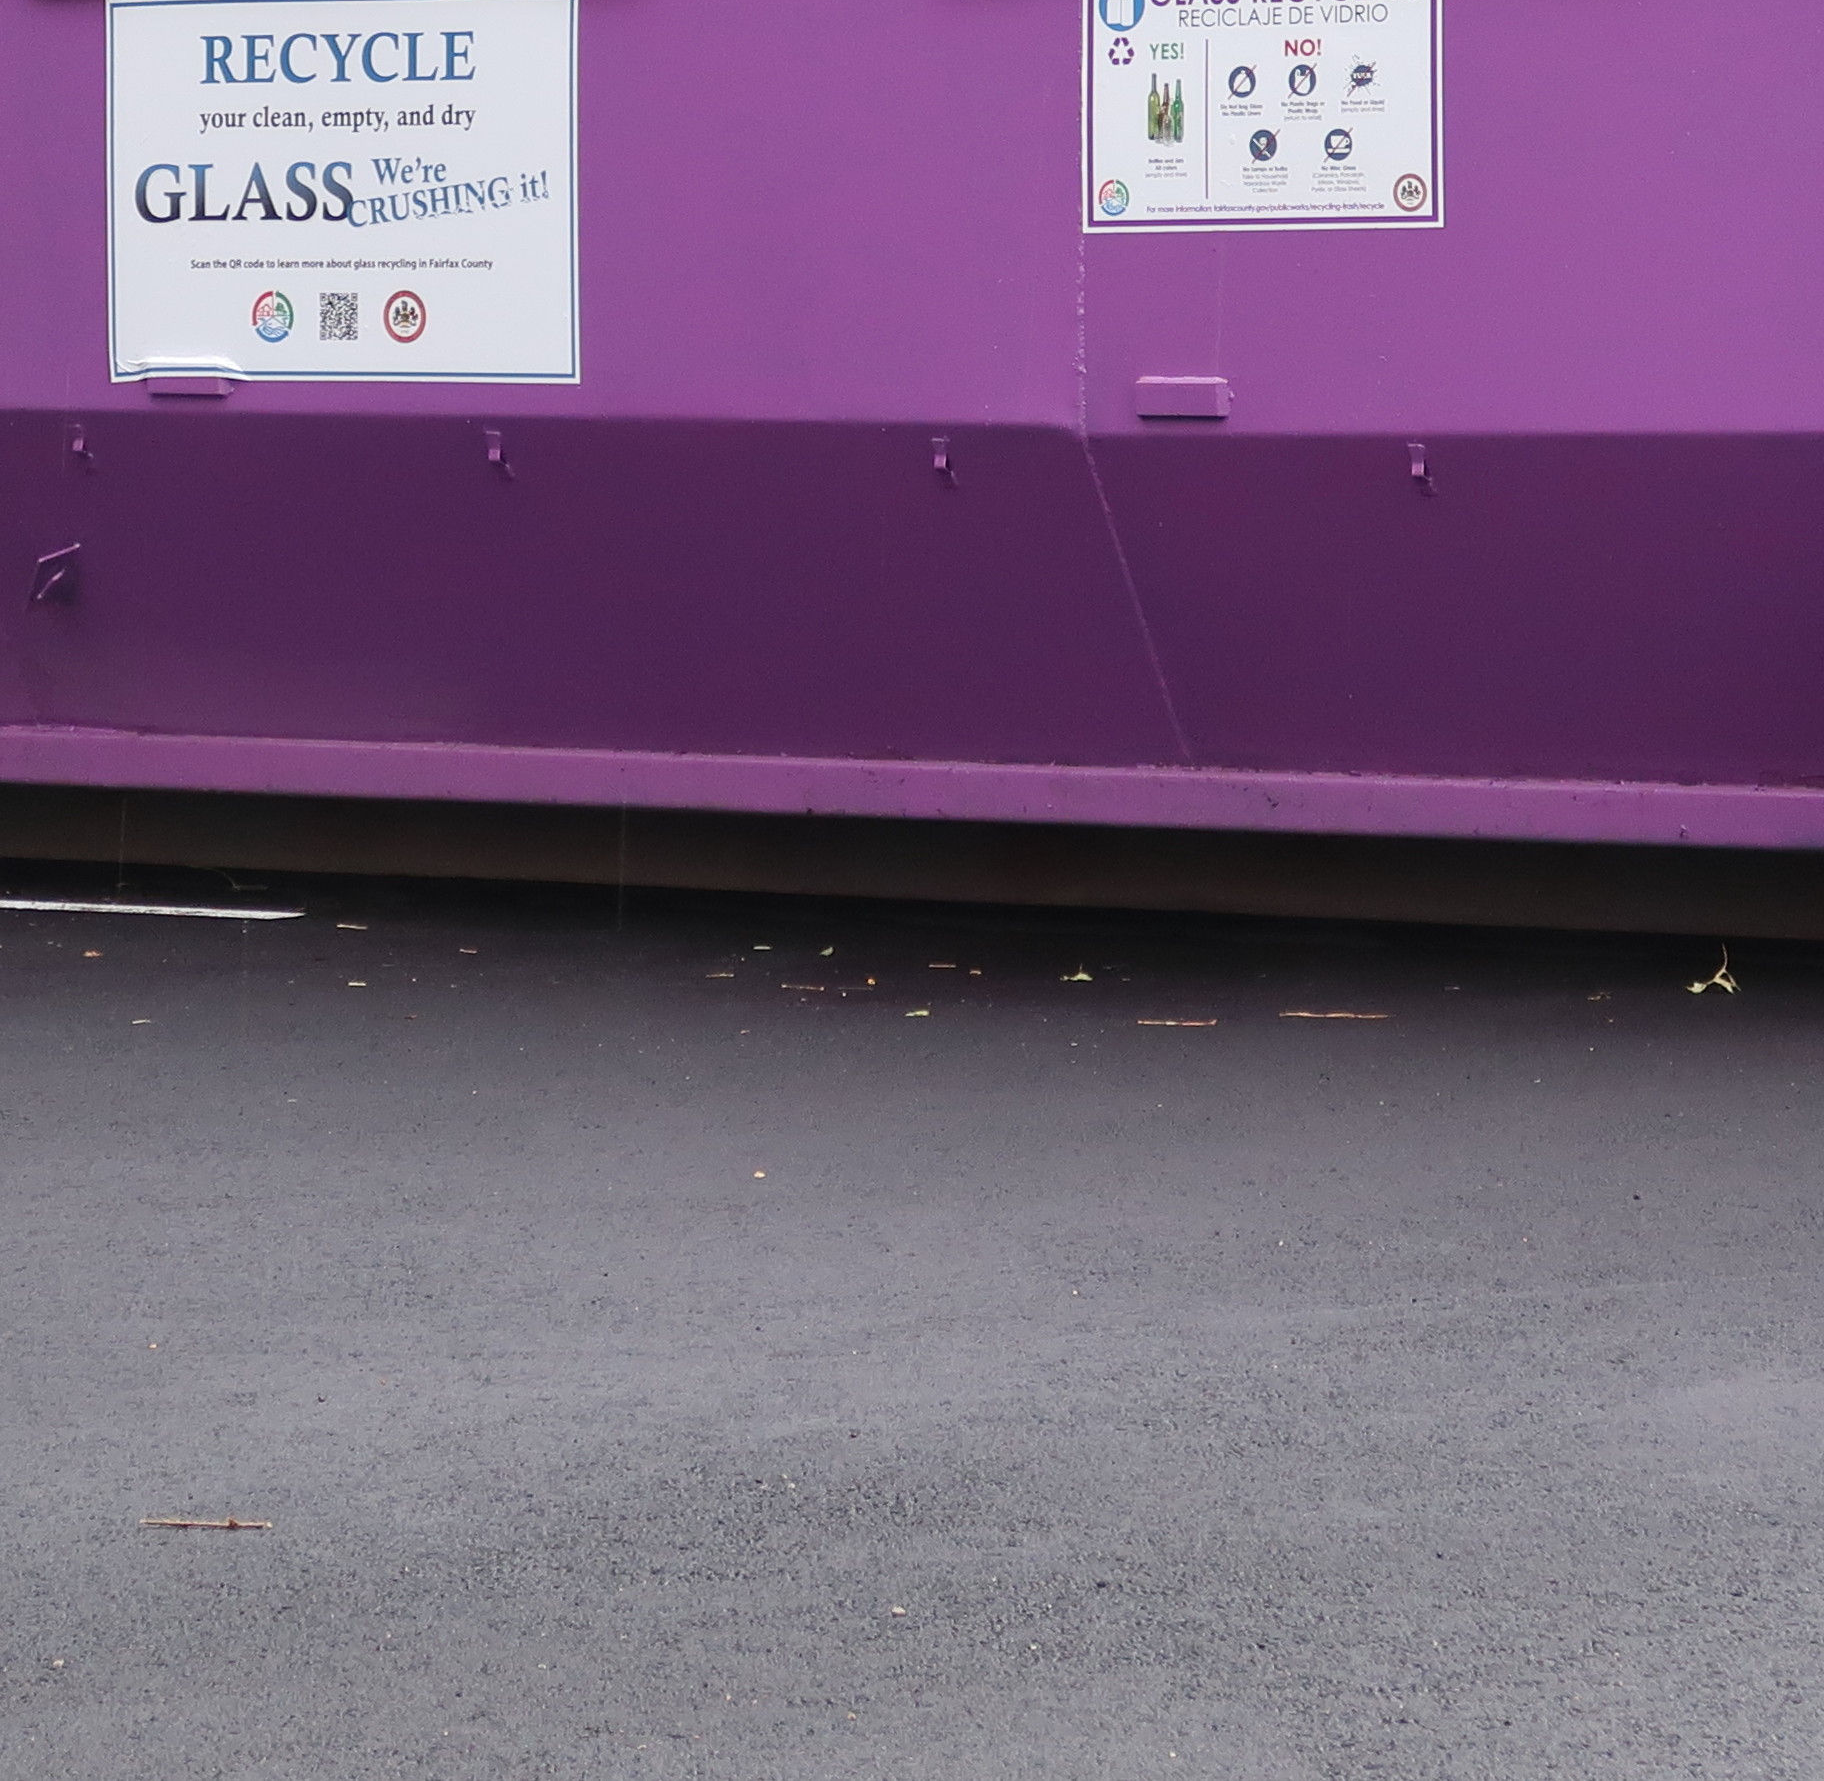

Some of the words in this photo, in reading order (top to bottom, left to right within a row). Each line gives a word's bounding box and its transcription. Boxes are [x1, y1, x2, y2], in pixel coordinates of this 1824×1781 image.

[1178, 6, 1283, 28] RECICLAJE
[1288, 5, 1314, 25] DE
[1319, 3, 1389, 24] VIDRIO
[199, 31, 476, 85] RECYCLE
[1149, 42, 1184, 60] YES!
[1284, 38, 1322, 57] NO!
[199, 110, 246, 133] your
[252, 106, 314, 132] clean,
[321, 108, 389, 133] empty,
[397, 105, 434, 126] and
[441, 104, 476, 130] dry
[134, 161, 354, 224] GLASS
[347, 175, 511, 228] CRUSHING
[519, 171, 549, 204] it!
[190, 259, 211, 269] Scan
[213, 259, 227, 269] the
[229, 259, 242, 269] QR
[243, 259, 264, 269] code
[266, 259, 275, 268] to
[277, 259, 299, 268] learn
[301, 260, 324, 268] more
[326, 259, 352, 268] about
[354, 259, 375, 270] glass
[377, 259, 416, 270] recycling
[419, 259, 427, 268] in
[429, 259, 459, 268] Fairfax
[461, 259, 493, 270] County
